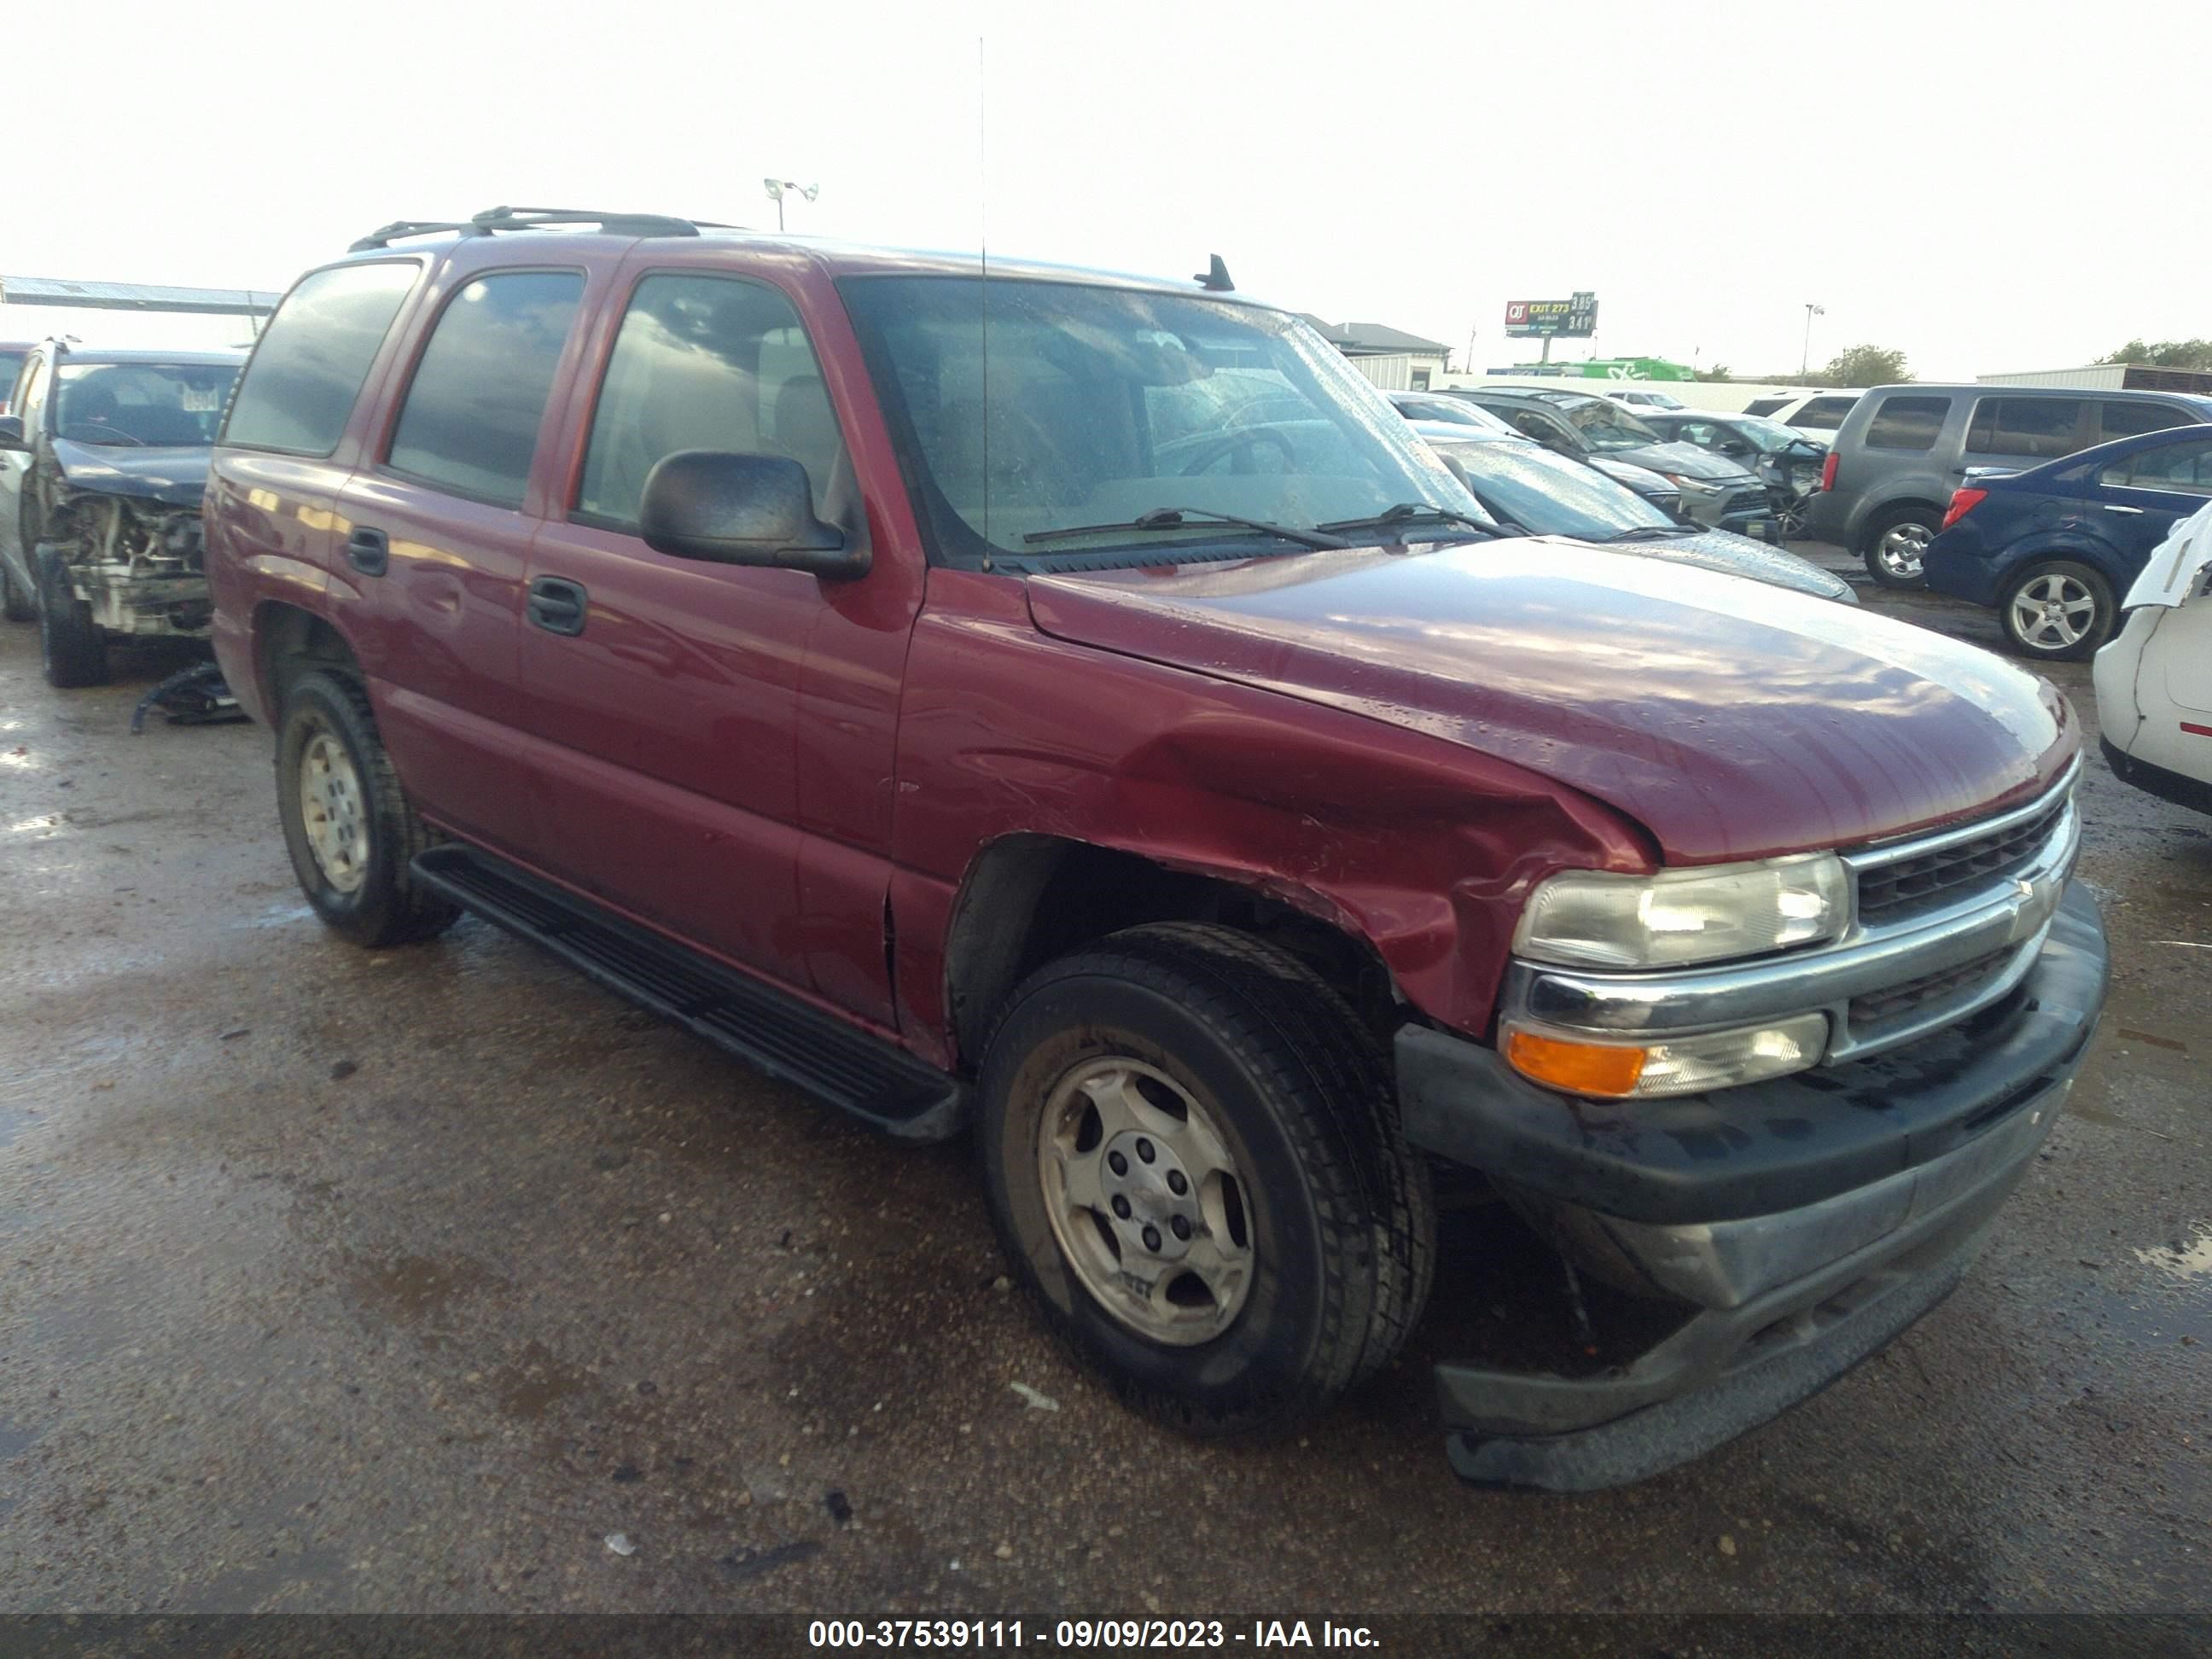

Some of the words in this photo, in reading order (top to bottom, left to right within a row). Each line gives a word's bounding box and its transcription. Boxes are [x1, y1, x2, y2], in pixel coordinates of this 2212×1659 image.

[1510, 305, 1525, 319] QT
[1529, 305, 1550, 313] EXIT
[1551, 304, 1569, 313] 273
